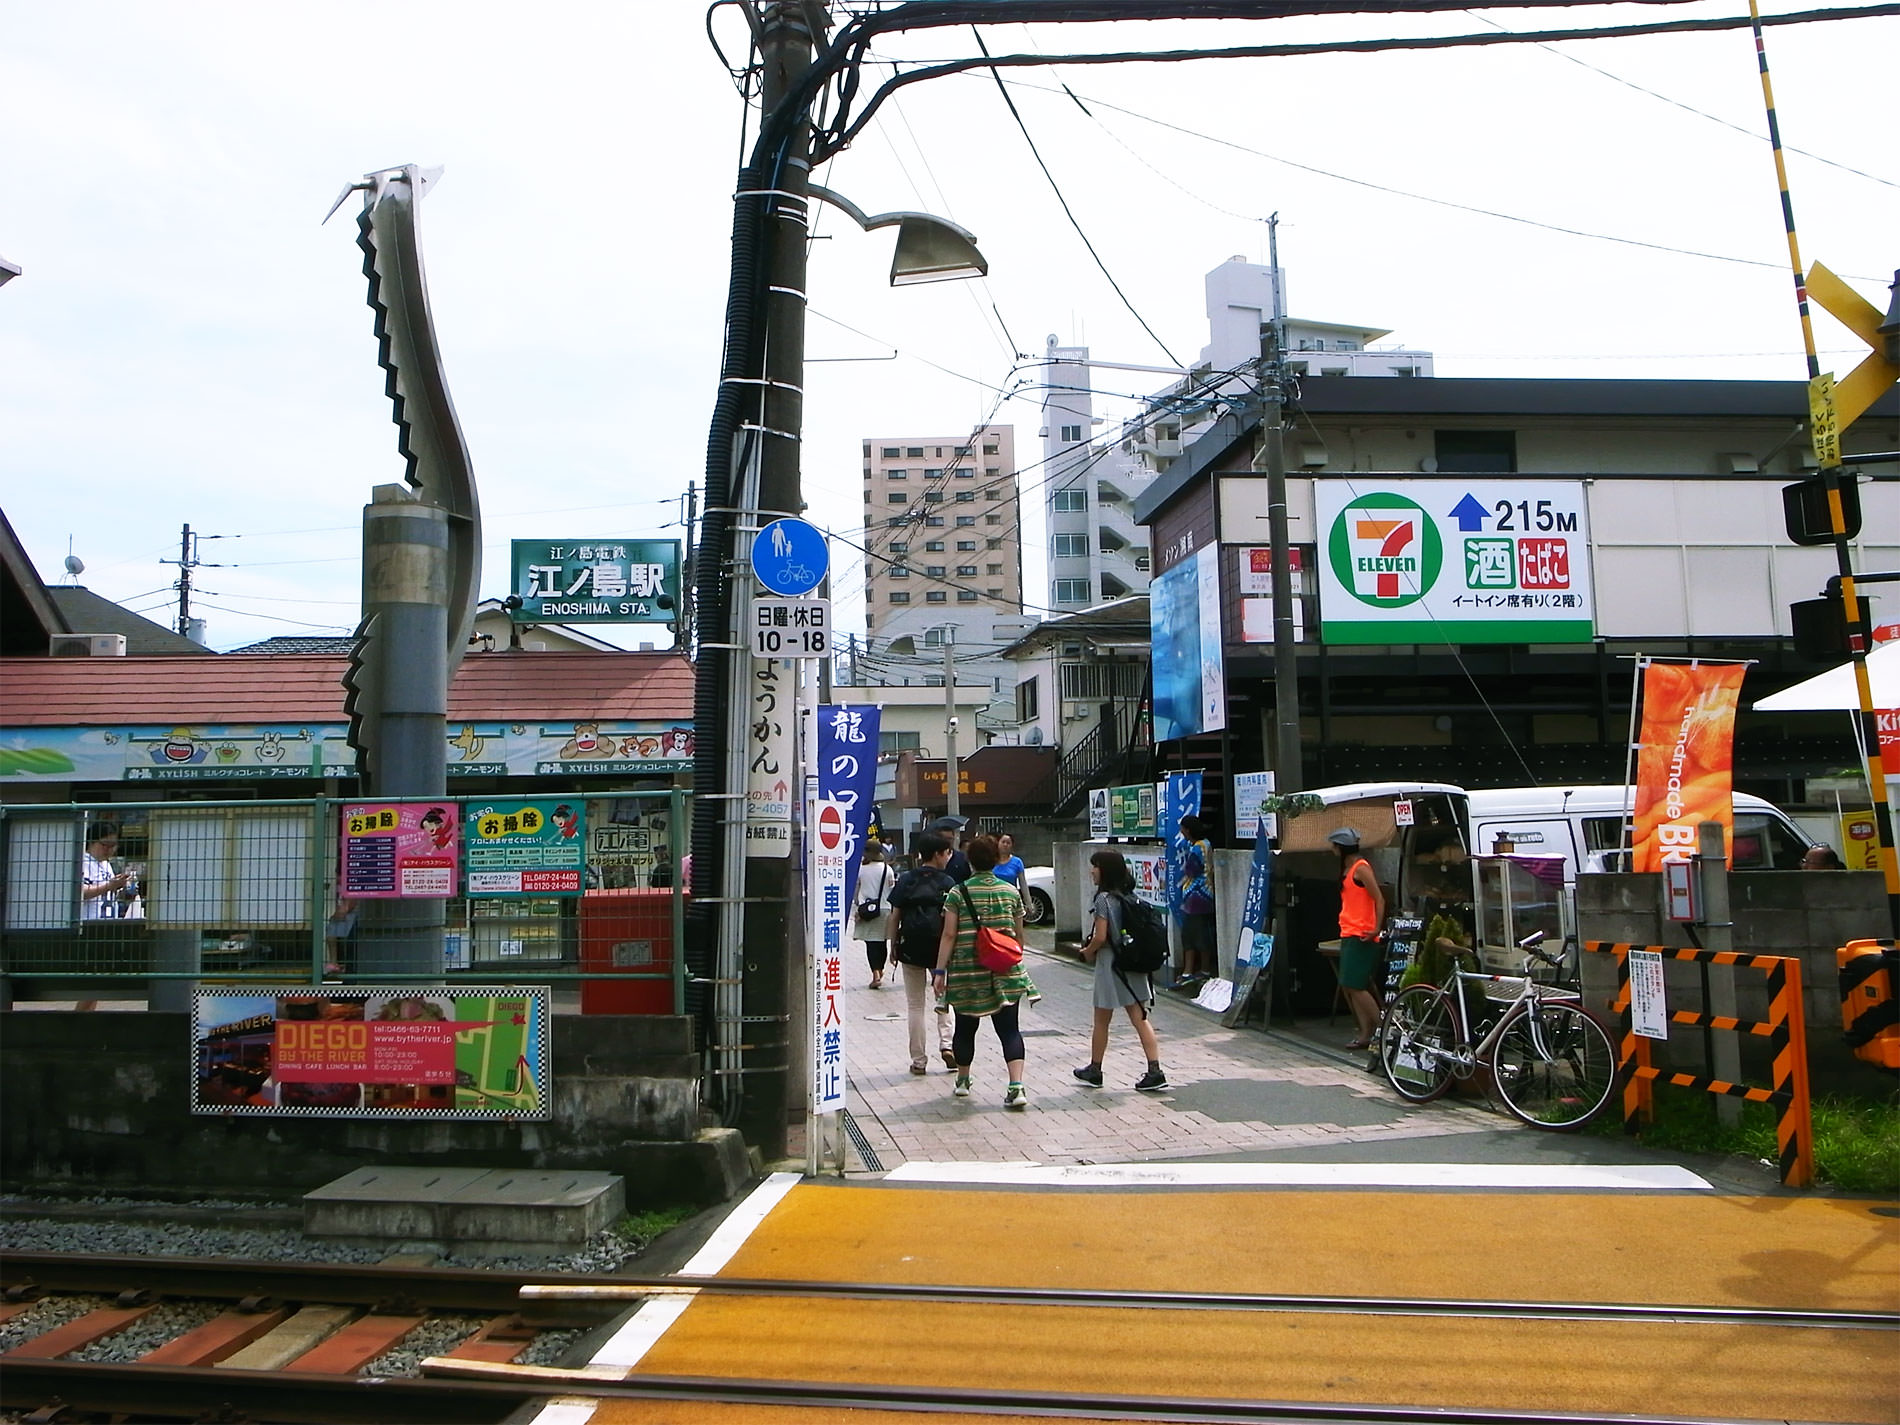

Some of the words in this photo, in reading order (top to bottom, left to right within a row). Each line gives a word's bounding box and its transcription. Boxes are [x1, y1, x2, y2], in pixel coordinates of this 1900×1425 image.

[1495, 500, 1577, 532] 215M
[550, 545, 627, 560] 江ノ島電鉄
[1467, 541, 1512, 585] 酒
[1520, 542, 1569, 584] たばこ
[526, 564, 665, 598] 江ノ島駅
[542, 603, 611, 615] ENOSHIMA
[620, 603, 650, 615] STA.
[758, 607, 824, 627] 日曜・休日
[271, 767, 309, 777] アーモンド
[464, 765, 502, 774] アーモンド
[1666, 706, 1695, 819] handmade
[1396, 803, 1411, 815] OPEN
[350, 812, 394, 833] お掃除
[484, 812, 538, 835] お掃除
[279, 1024, 367, 1049] DIEGO
[374, 1034, 452, 1044] www.bytheriver.jp
[302, 1051, 323, 1062] THE
[329, 1051, 366, 1062] RIVER
